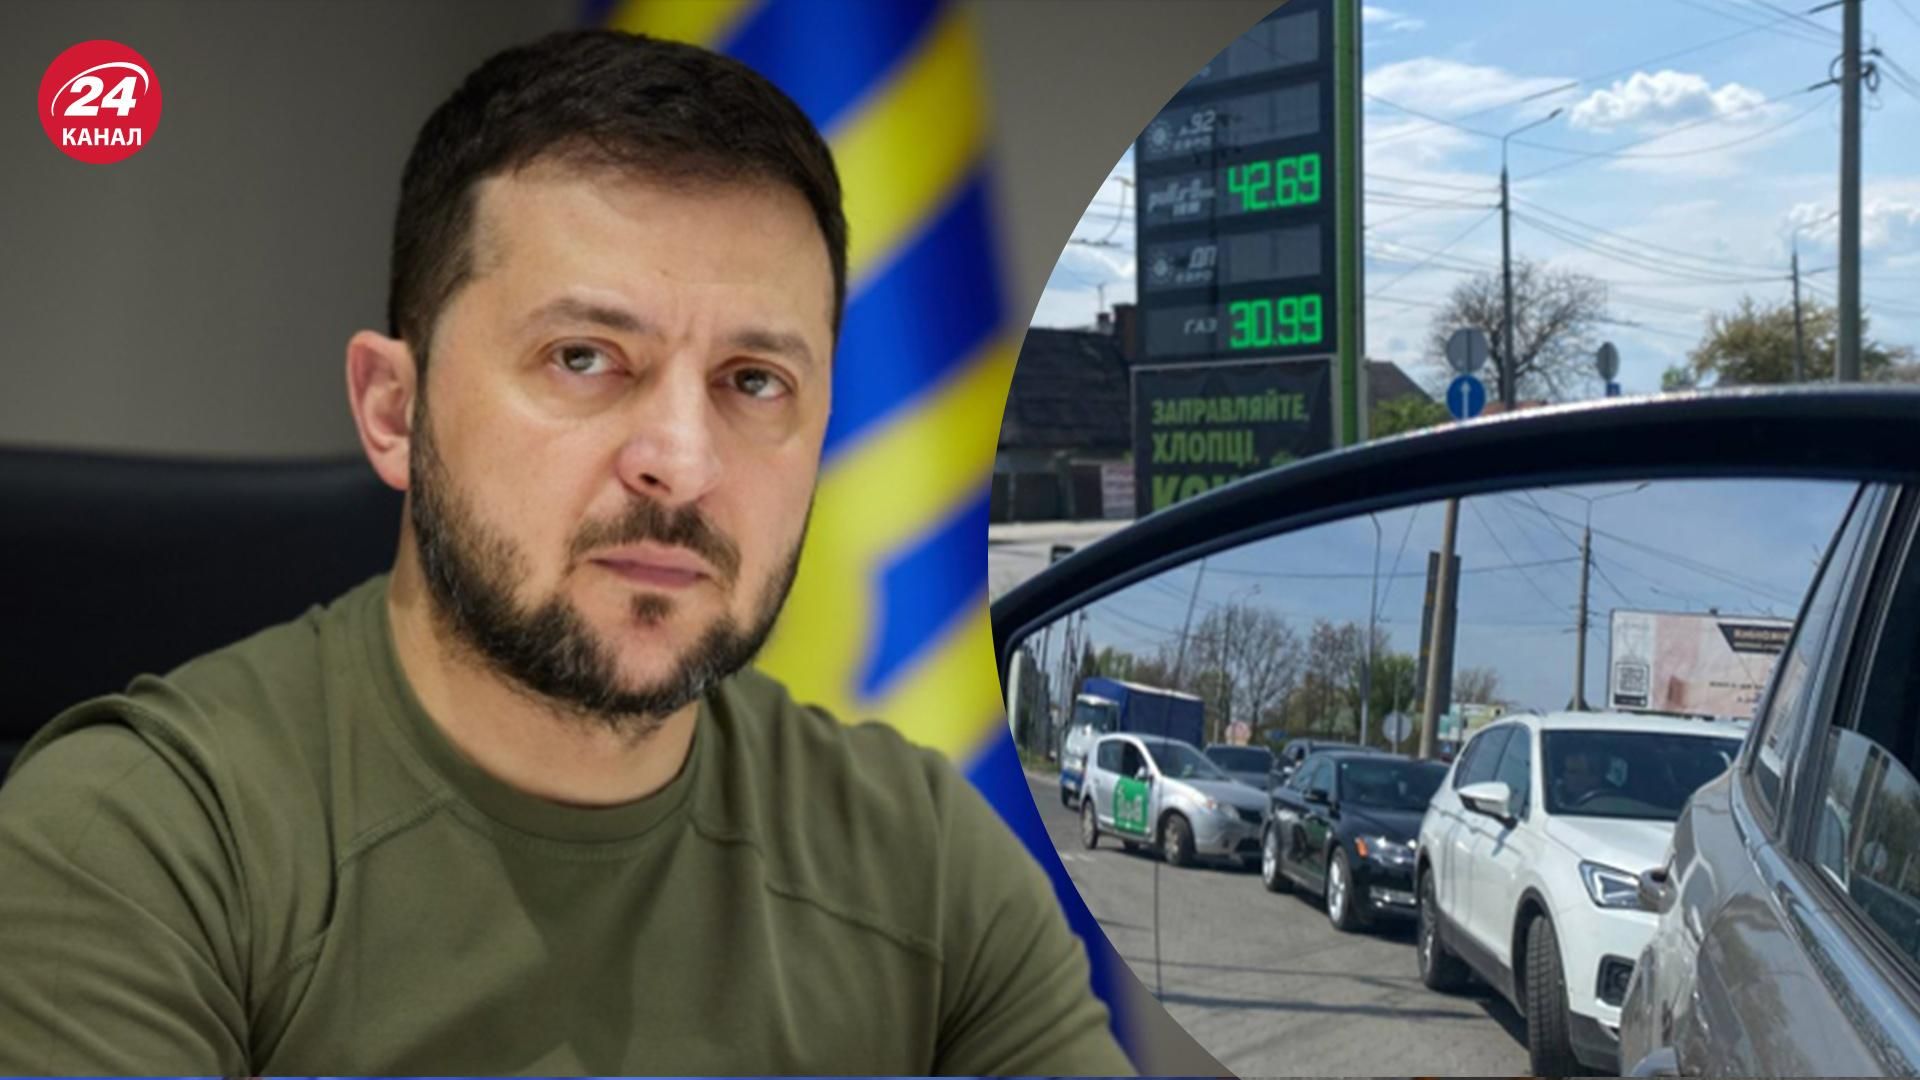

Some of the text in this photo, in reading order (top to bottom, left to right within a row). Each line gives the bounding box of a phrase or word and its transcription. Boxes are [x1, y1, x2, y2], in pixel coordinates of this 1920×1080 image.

[1227, 152, 1322, 214] 42.69
[1183, 317, 1218, 335] ГАЗ
[1228, 293, 1323, 349] 30.99
[1152, 388, 1310, 425] ЗАПРАВЛЯЙТЕ,
